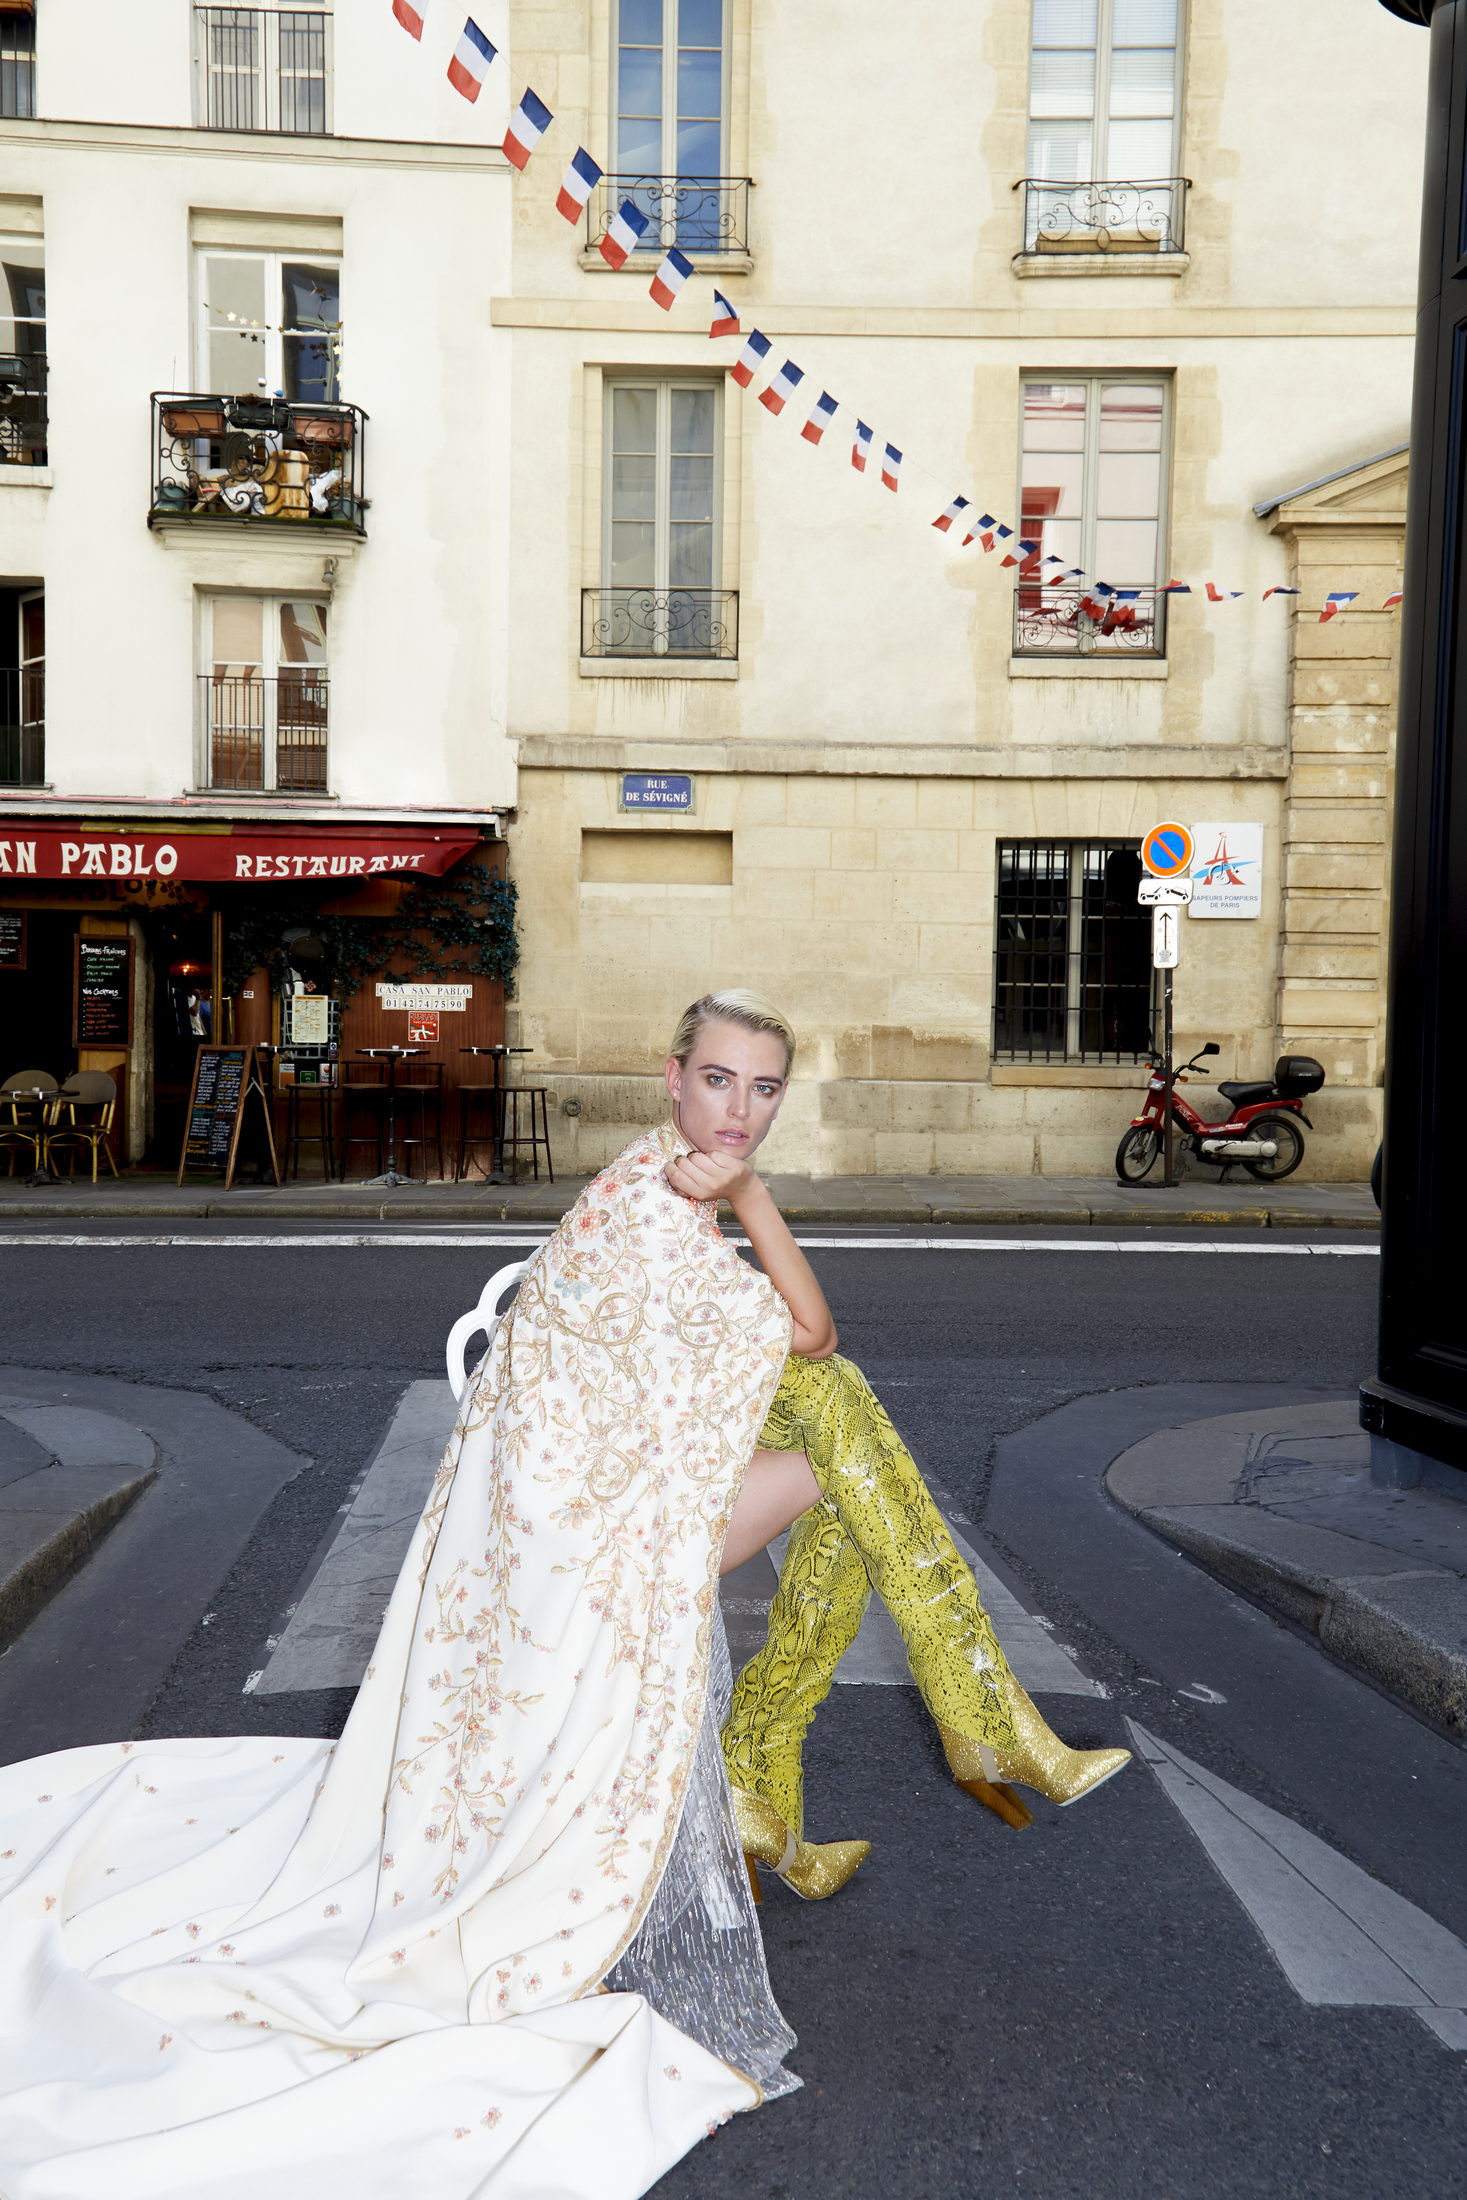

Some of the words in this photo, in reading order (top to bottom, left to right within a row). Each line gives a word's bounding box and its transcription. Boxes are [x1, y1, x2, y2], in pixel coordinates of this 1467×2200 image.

[647, 779, 668, 789] RUE
[625, 792, 640, 802] DE
[643, 790, 688, 803] SÉVIGNÉ
[61, 842, 179, 876] PABLO
[235, 853, 425, 878] RESTAURANT
[379, 986, 405, 994] CASA
[412, 987, 431, 995] SAN
[437, 987, 469, 996] PABLO
[386, 999, 397, 1007] 01
[402, 999, 414, 1008] 42
[418, 1000, 429, 1008] 74
[434, 1000, 446, 1008] 75
[450, 1000, 462, 1009] 90
